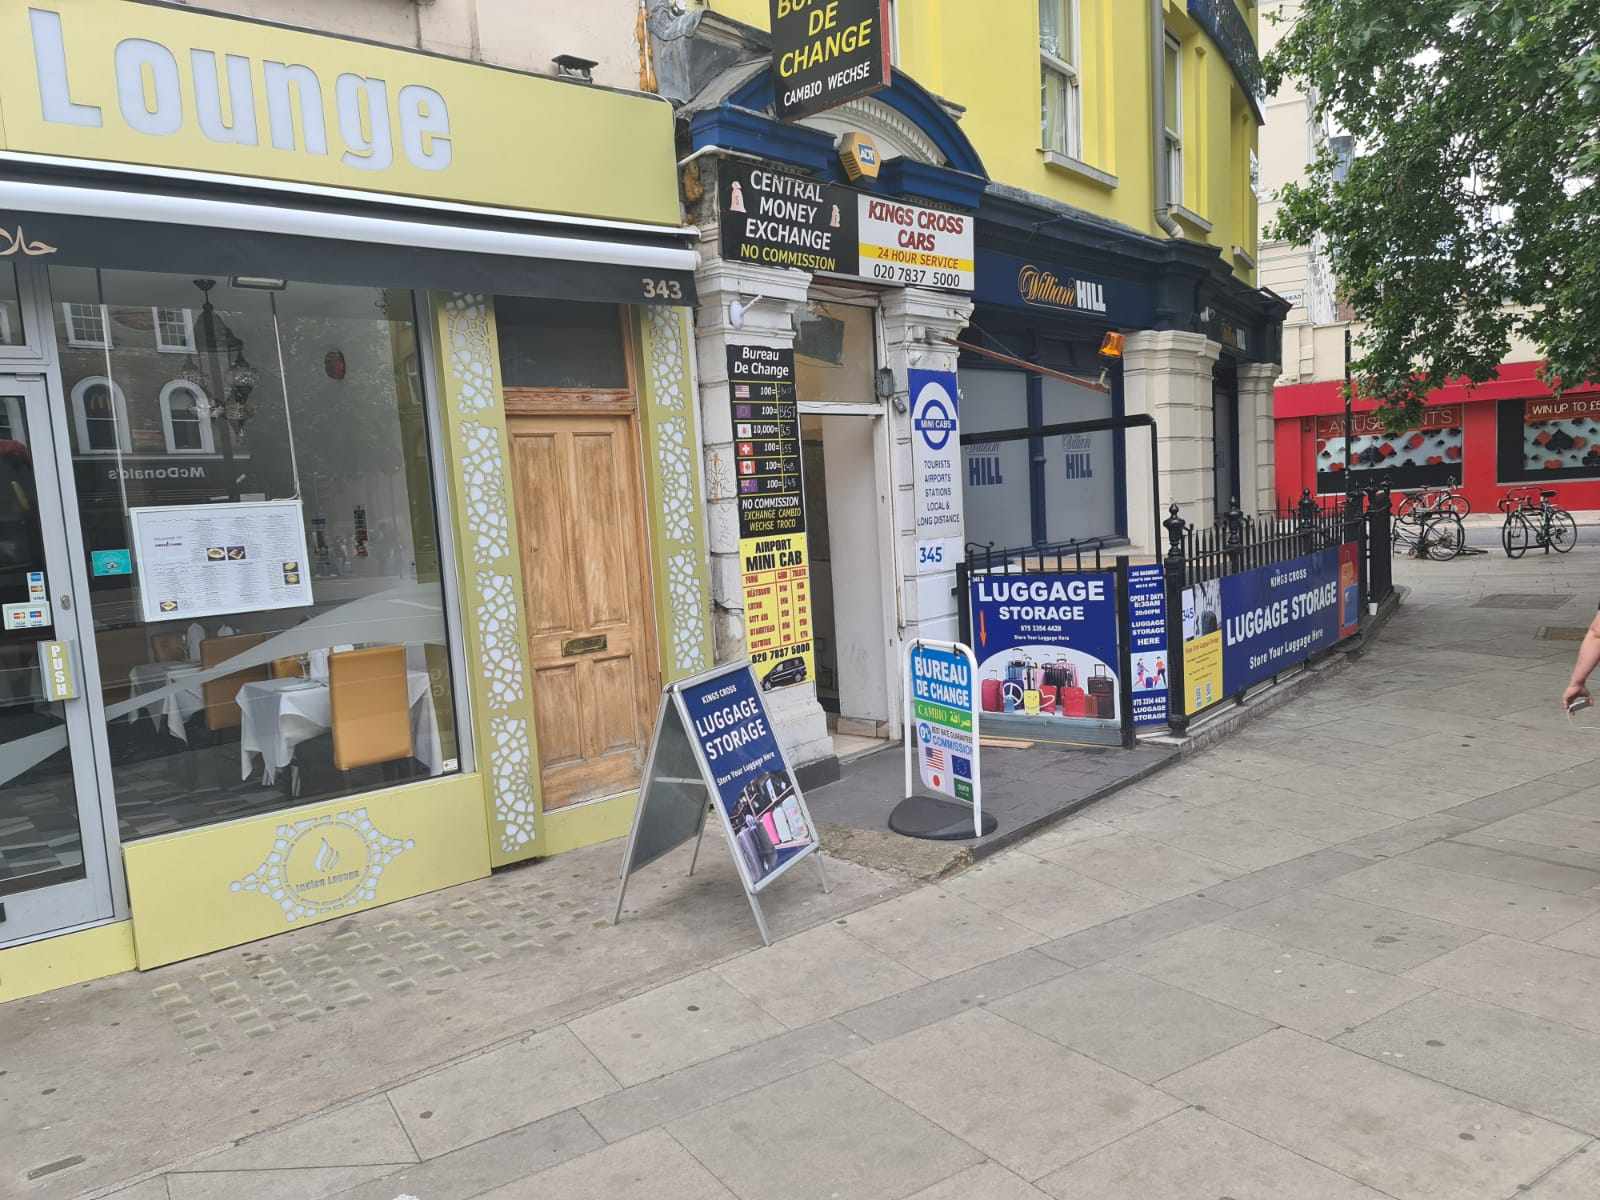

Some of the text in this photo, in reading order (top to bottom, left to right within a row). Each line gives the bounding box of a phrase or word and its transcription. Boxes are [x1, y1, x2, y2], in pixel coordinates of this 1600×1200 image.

[808, 2, 838, 37] DE
[779, 18, 873, 78] CHANGE
[27, 6, 454, 171] Lounge
[783, 61, 871, 106] CAMBIO WECHSE
[750, 170, 824, 203] CENTRAL
[760, 196, 818, 224] MONEY
[868, 200, 964, 235] KINGS CROSS
[746, 218, 831, 250] EXCHANGE
[897, 229, 936, 251] CARS
[741, 243, 836, 272] NO COMMISSION
[878, 247, 959, 269] 24 HOUR SERVICE
[873, 264, 960, 287] 020 7837 5000
[642, 278, 682, 299] 343
[1018, 265, 1106, 313] William HILL
[742, 347, 780, 361] Bureau
[734, 361, 789, 378] De Change
[1532, 404, 1552, 415] WIN
[1554, 403, 1568, 414] UP
[1572, 402, 1587, 411] TO
[921, 419, 952, 429] MINI CABS
[1329, 410, 1453, 433] AMUSTS
[924, 460, 951, 469] TOURISTS
[968, 457, 1003, 486] HILL
[1066, 453, 1093, 480] HILL
[925, 473, 952, 483] AIRPORTS
[742, 496, 800, 510] NO COMMISSION
[925, 488, 952, 497] STATIONS
[744, 508, 802, 521] EXCHANGE CAMBIO
[927, 502, 945, 511] LOCAL
[917, 514, 960, 526] LONG DISTANCE
[755, 538, 792, 554] AIRPORT
[919, 547, 943, 563] 345
[746, 554, 776, 572] MINI
[779, 550, 803, 568] CAB
[1270, 568, 1307, 588] KINGS CROSS
[978, 580, 1105, 602] LUGGAGE
[999, 606, 1085, 621] STORAGE
[1131, 619, 1165, 628] LUGGAGE
[1226, 580, 1337, 647] LUGGAGE STORAGE
[1132, 627, 1165, 636] STORAGE
[1137, 637, 1160, 646] HERE
[752, 643, 810, 664] 020 7837 5000
[1249, 628, 1323, 670] Store Your Luggage Here
[51, 645, 67, 695] PUSH
[914, 656, 968, 687] BUREAU
[702, 684, 737, 705] KINGS CROSS
[916, 682, 970, 708] DE CHANGE
[696, 697, 759, 737] LUGGAGE
[1133, 705, 1166, 714] LUGGAGE
[1133, 713, 1166, 722] STORAGE
[706, 719, 766, 760] STORAGE
[932, 735, 972, 754] COMMISSIO
[717, 751, 775, 786] Store Your Luggage Here
